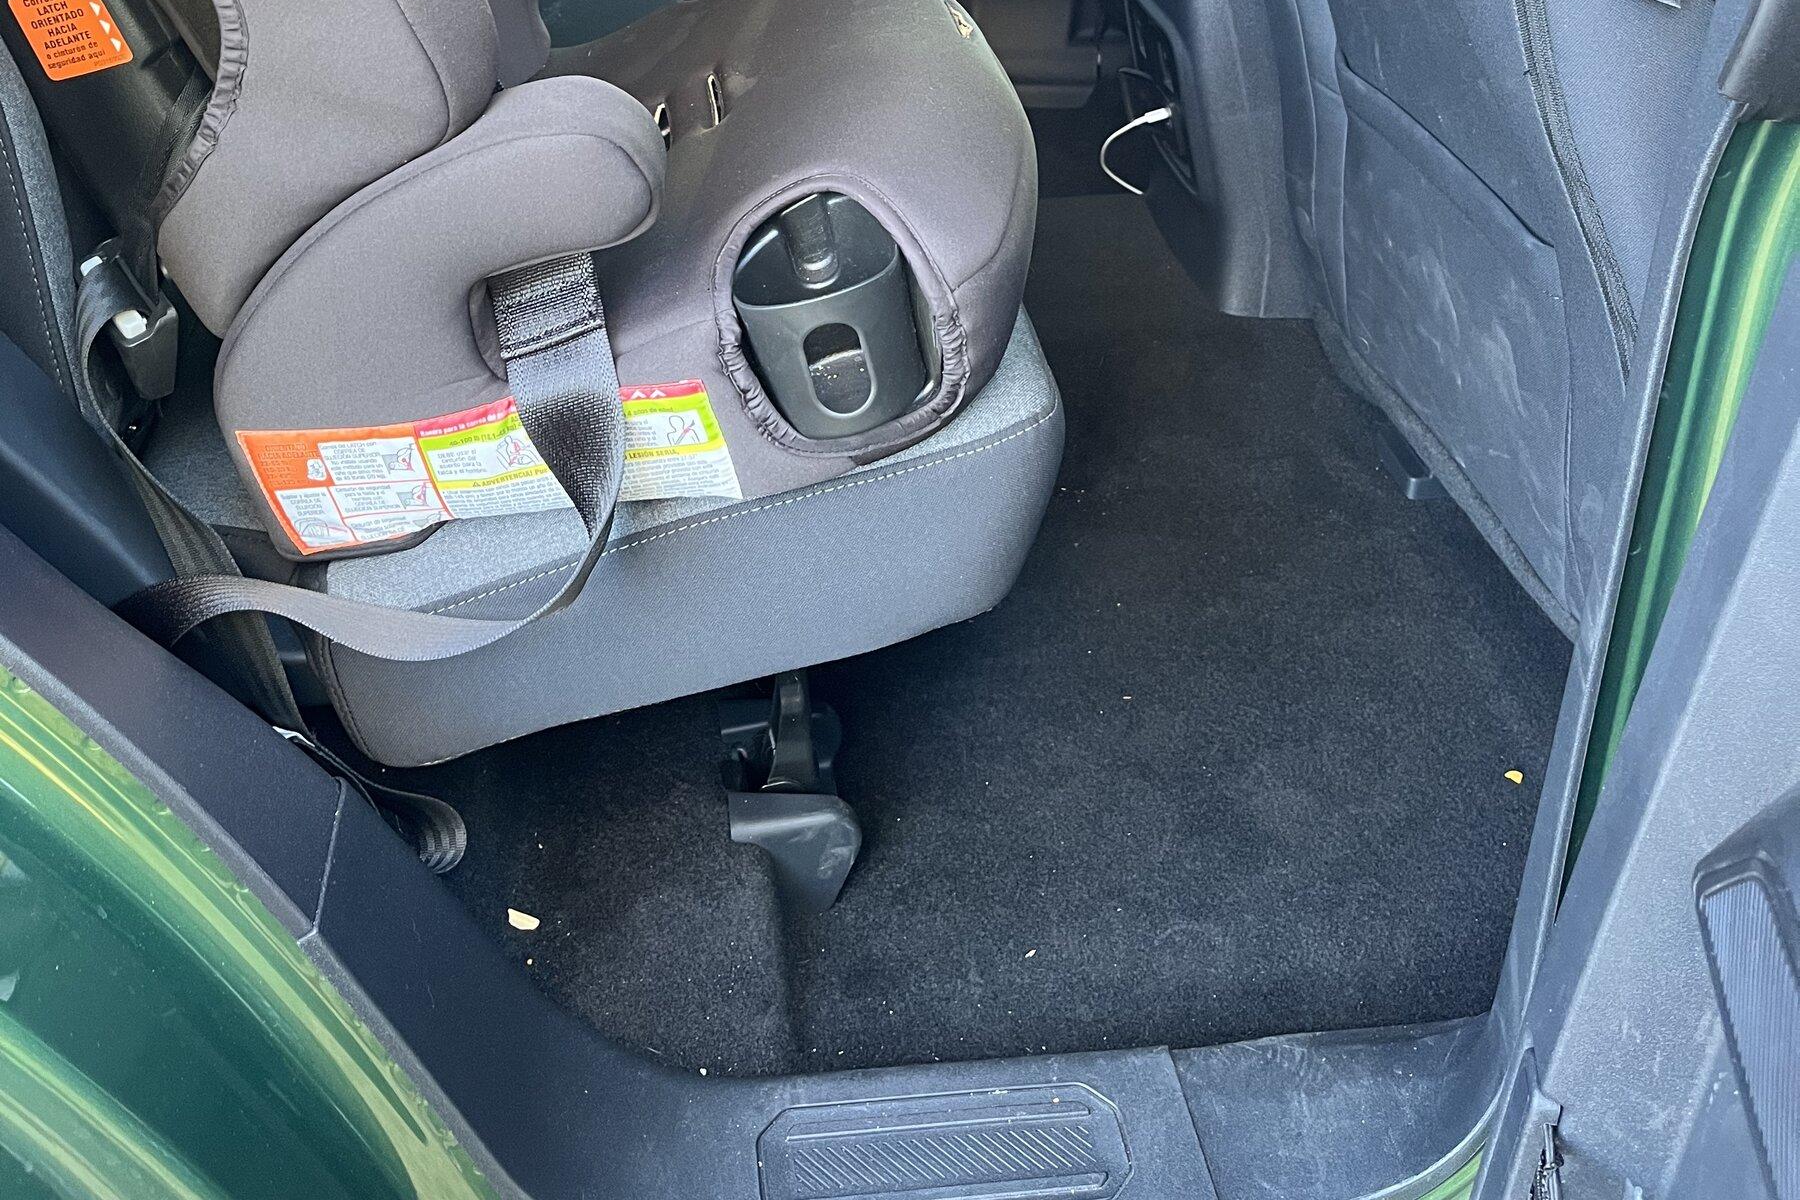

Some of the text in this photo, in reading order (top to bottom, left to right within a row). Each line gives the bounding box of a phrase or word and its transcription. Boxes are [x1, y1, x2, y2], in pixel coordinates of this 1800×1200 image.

[37, 1, 68, 16] LATCH
[30, 8, 84, 29] ORIENTADO
[47, 22, 78, 37] HACIA
[44, 30, 92, 50] ADELANTE
[88, 40, 99, 49] de
